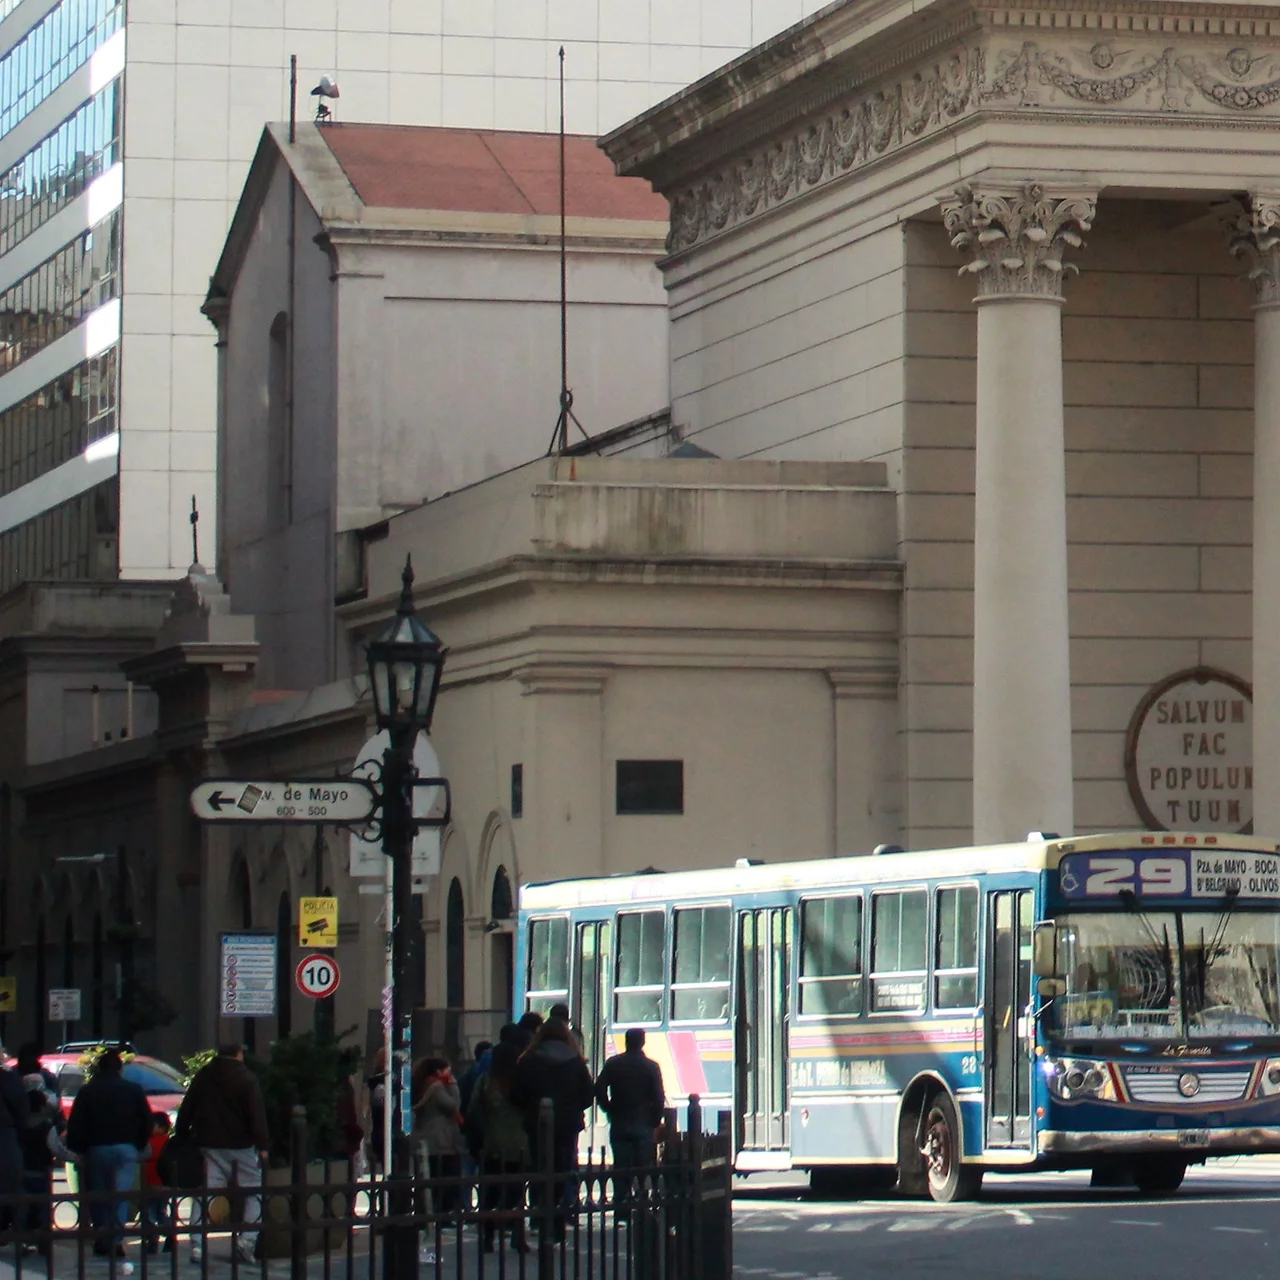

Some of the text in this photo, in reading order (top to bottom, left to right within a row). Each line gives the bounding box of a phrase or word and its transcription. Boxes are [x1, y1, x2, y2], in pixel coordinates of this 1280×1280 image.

[1156, 699, 1245, 724] SALVUM
[1182, 731, 1226, 756] FAC
[261, 787, 349, 804] v. de Mayo
[276, 806, 296, 816] 600
[308, 806, 327, 816] 500
[1166, 799, 1241, 823] TUUM
[1086, 857, 1187, 895] 29
[1213, 859, 1223, 874] de
[1224, 860, 1246, 874] MAYO
[1254, 860, 1279, 875] BOCA
[1249, 878, 1280, 893] OLIVOS
[305, 966, 331, 986] 10
[961, 1055, 977, 1075] 28
